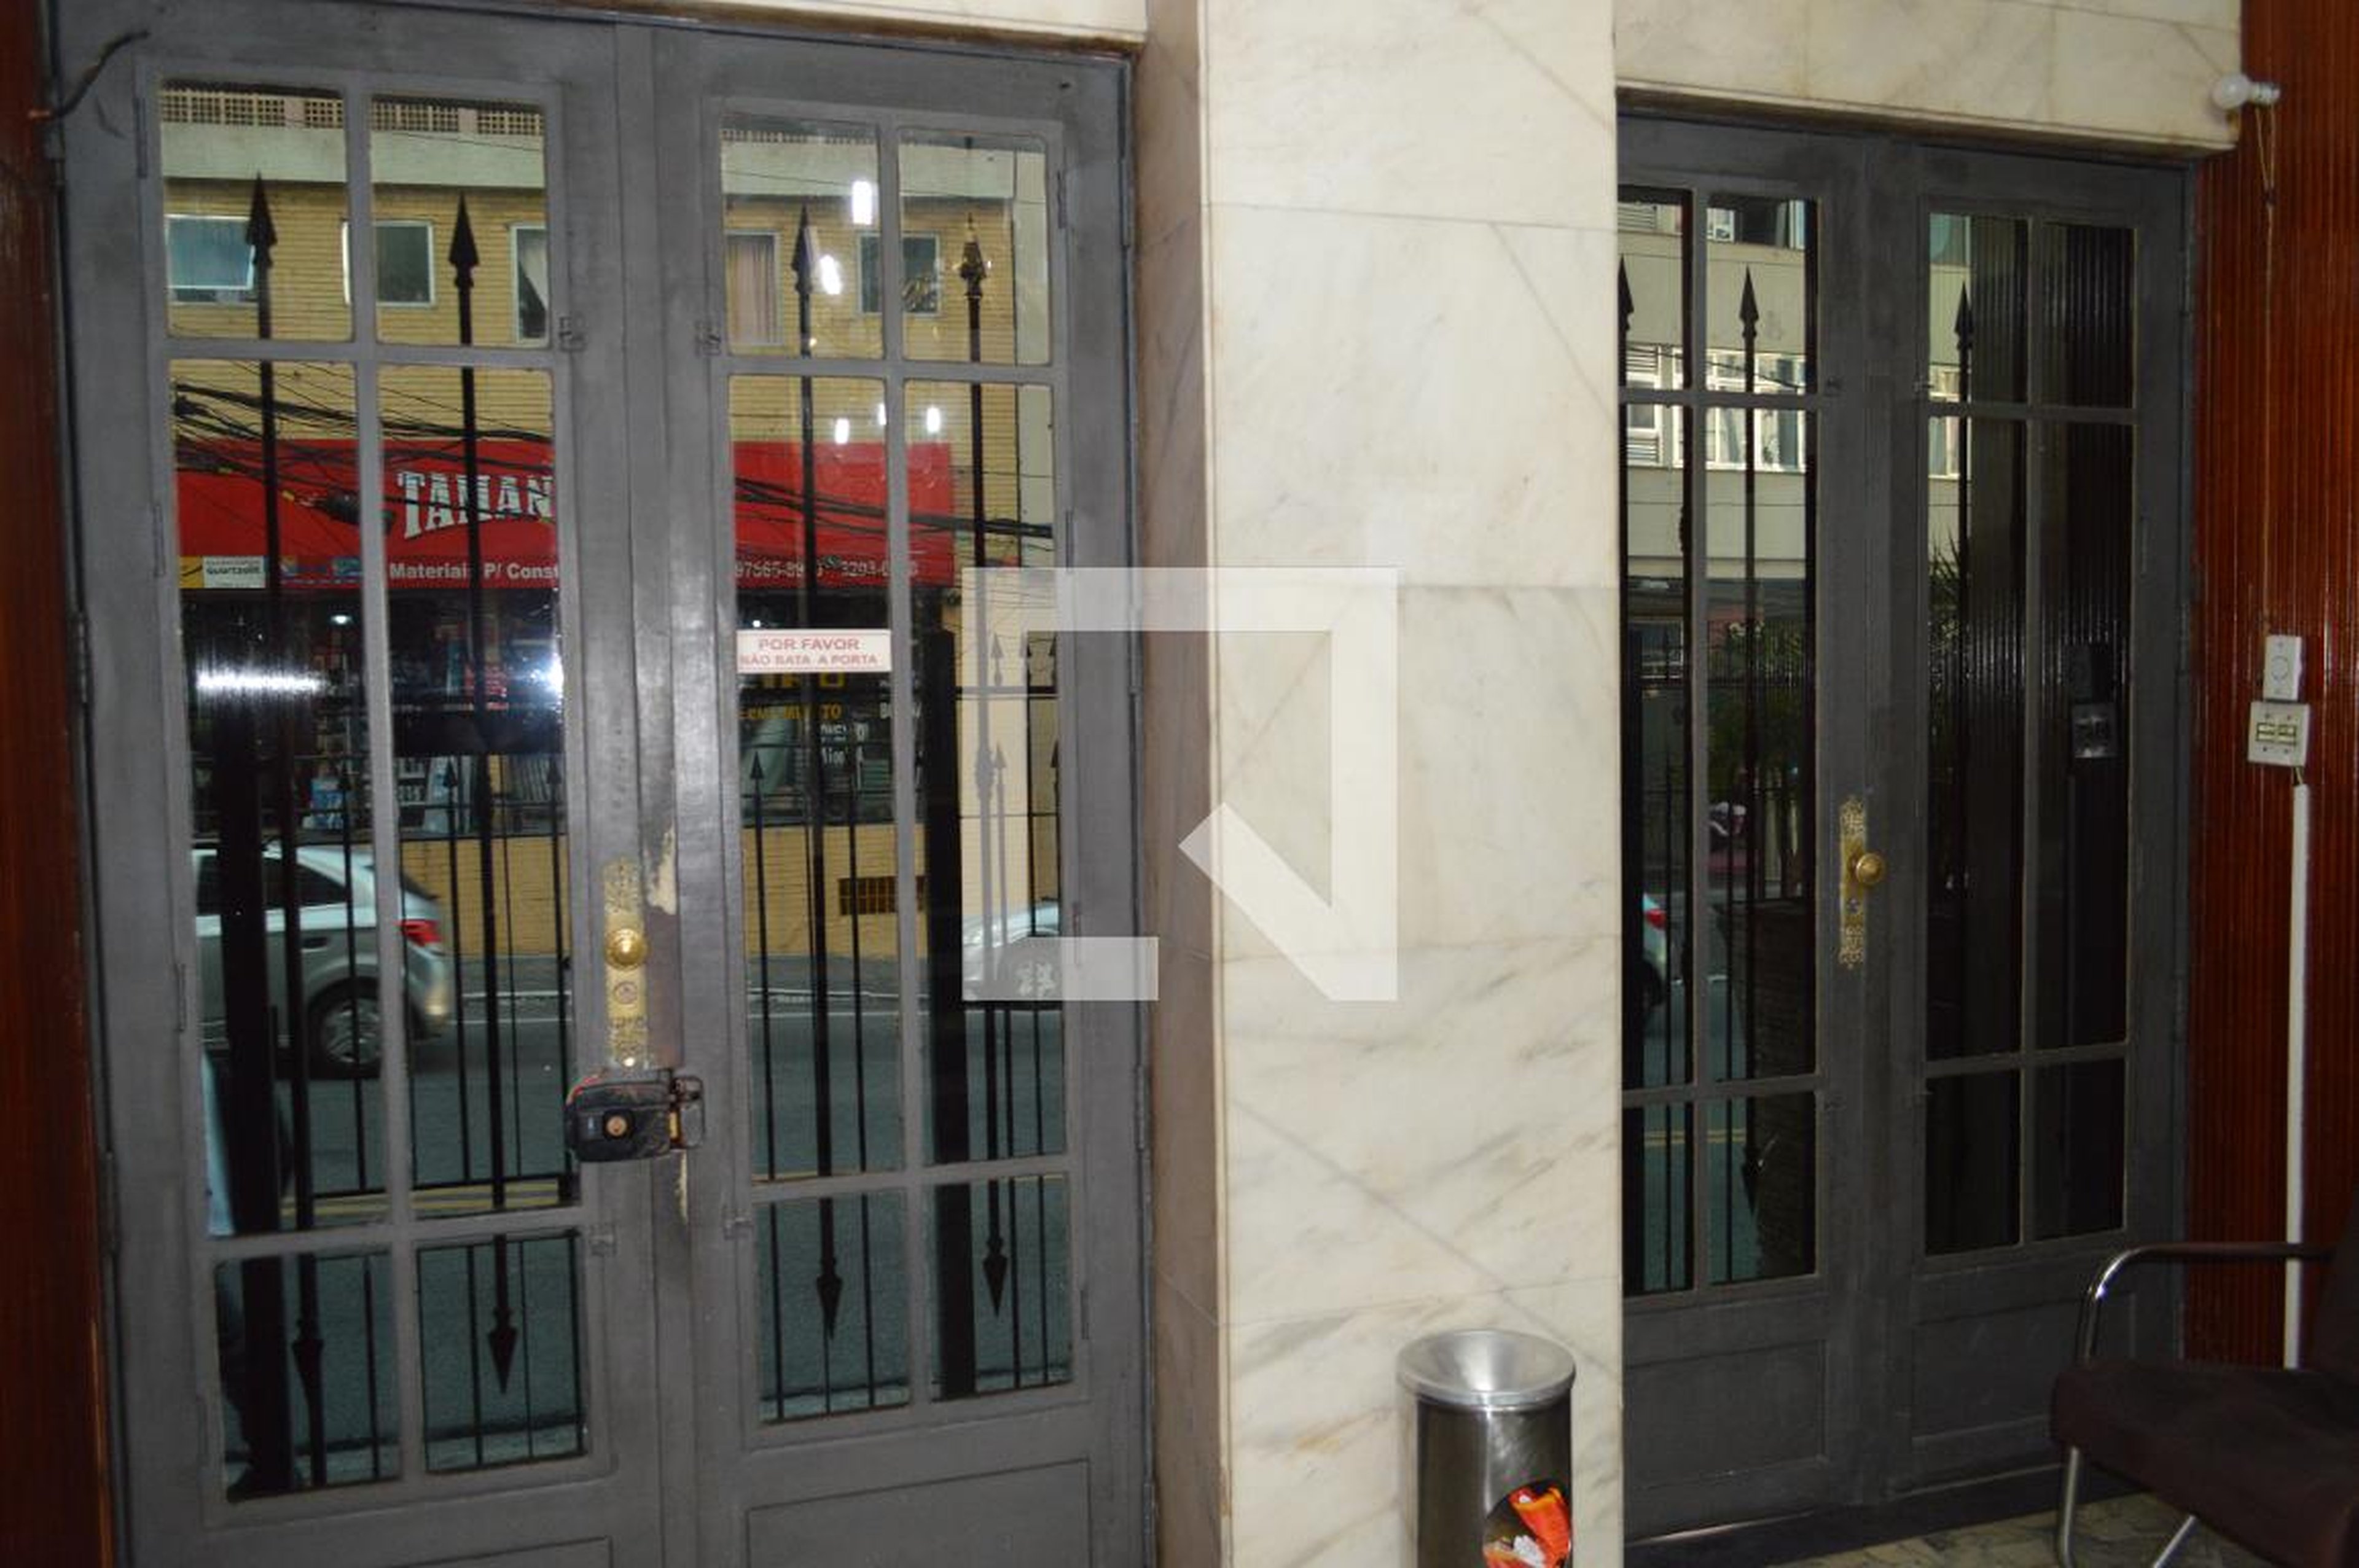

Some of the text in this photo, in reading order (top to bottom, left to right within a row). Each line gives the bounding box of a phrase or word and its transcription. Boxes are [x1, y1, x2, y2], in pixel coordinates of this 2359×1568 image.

[759, 638, 860, 651] POR FAVOR
[740, 653, 878, 665] NÃO BATA A PORTA
